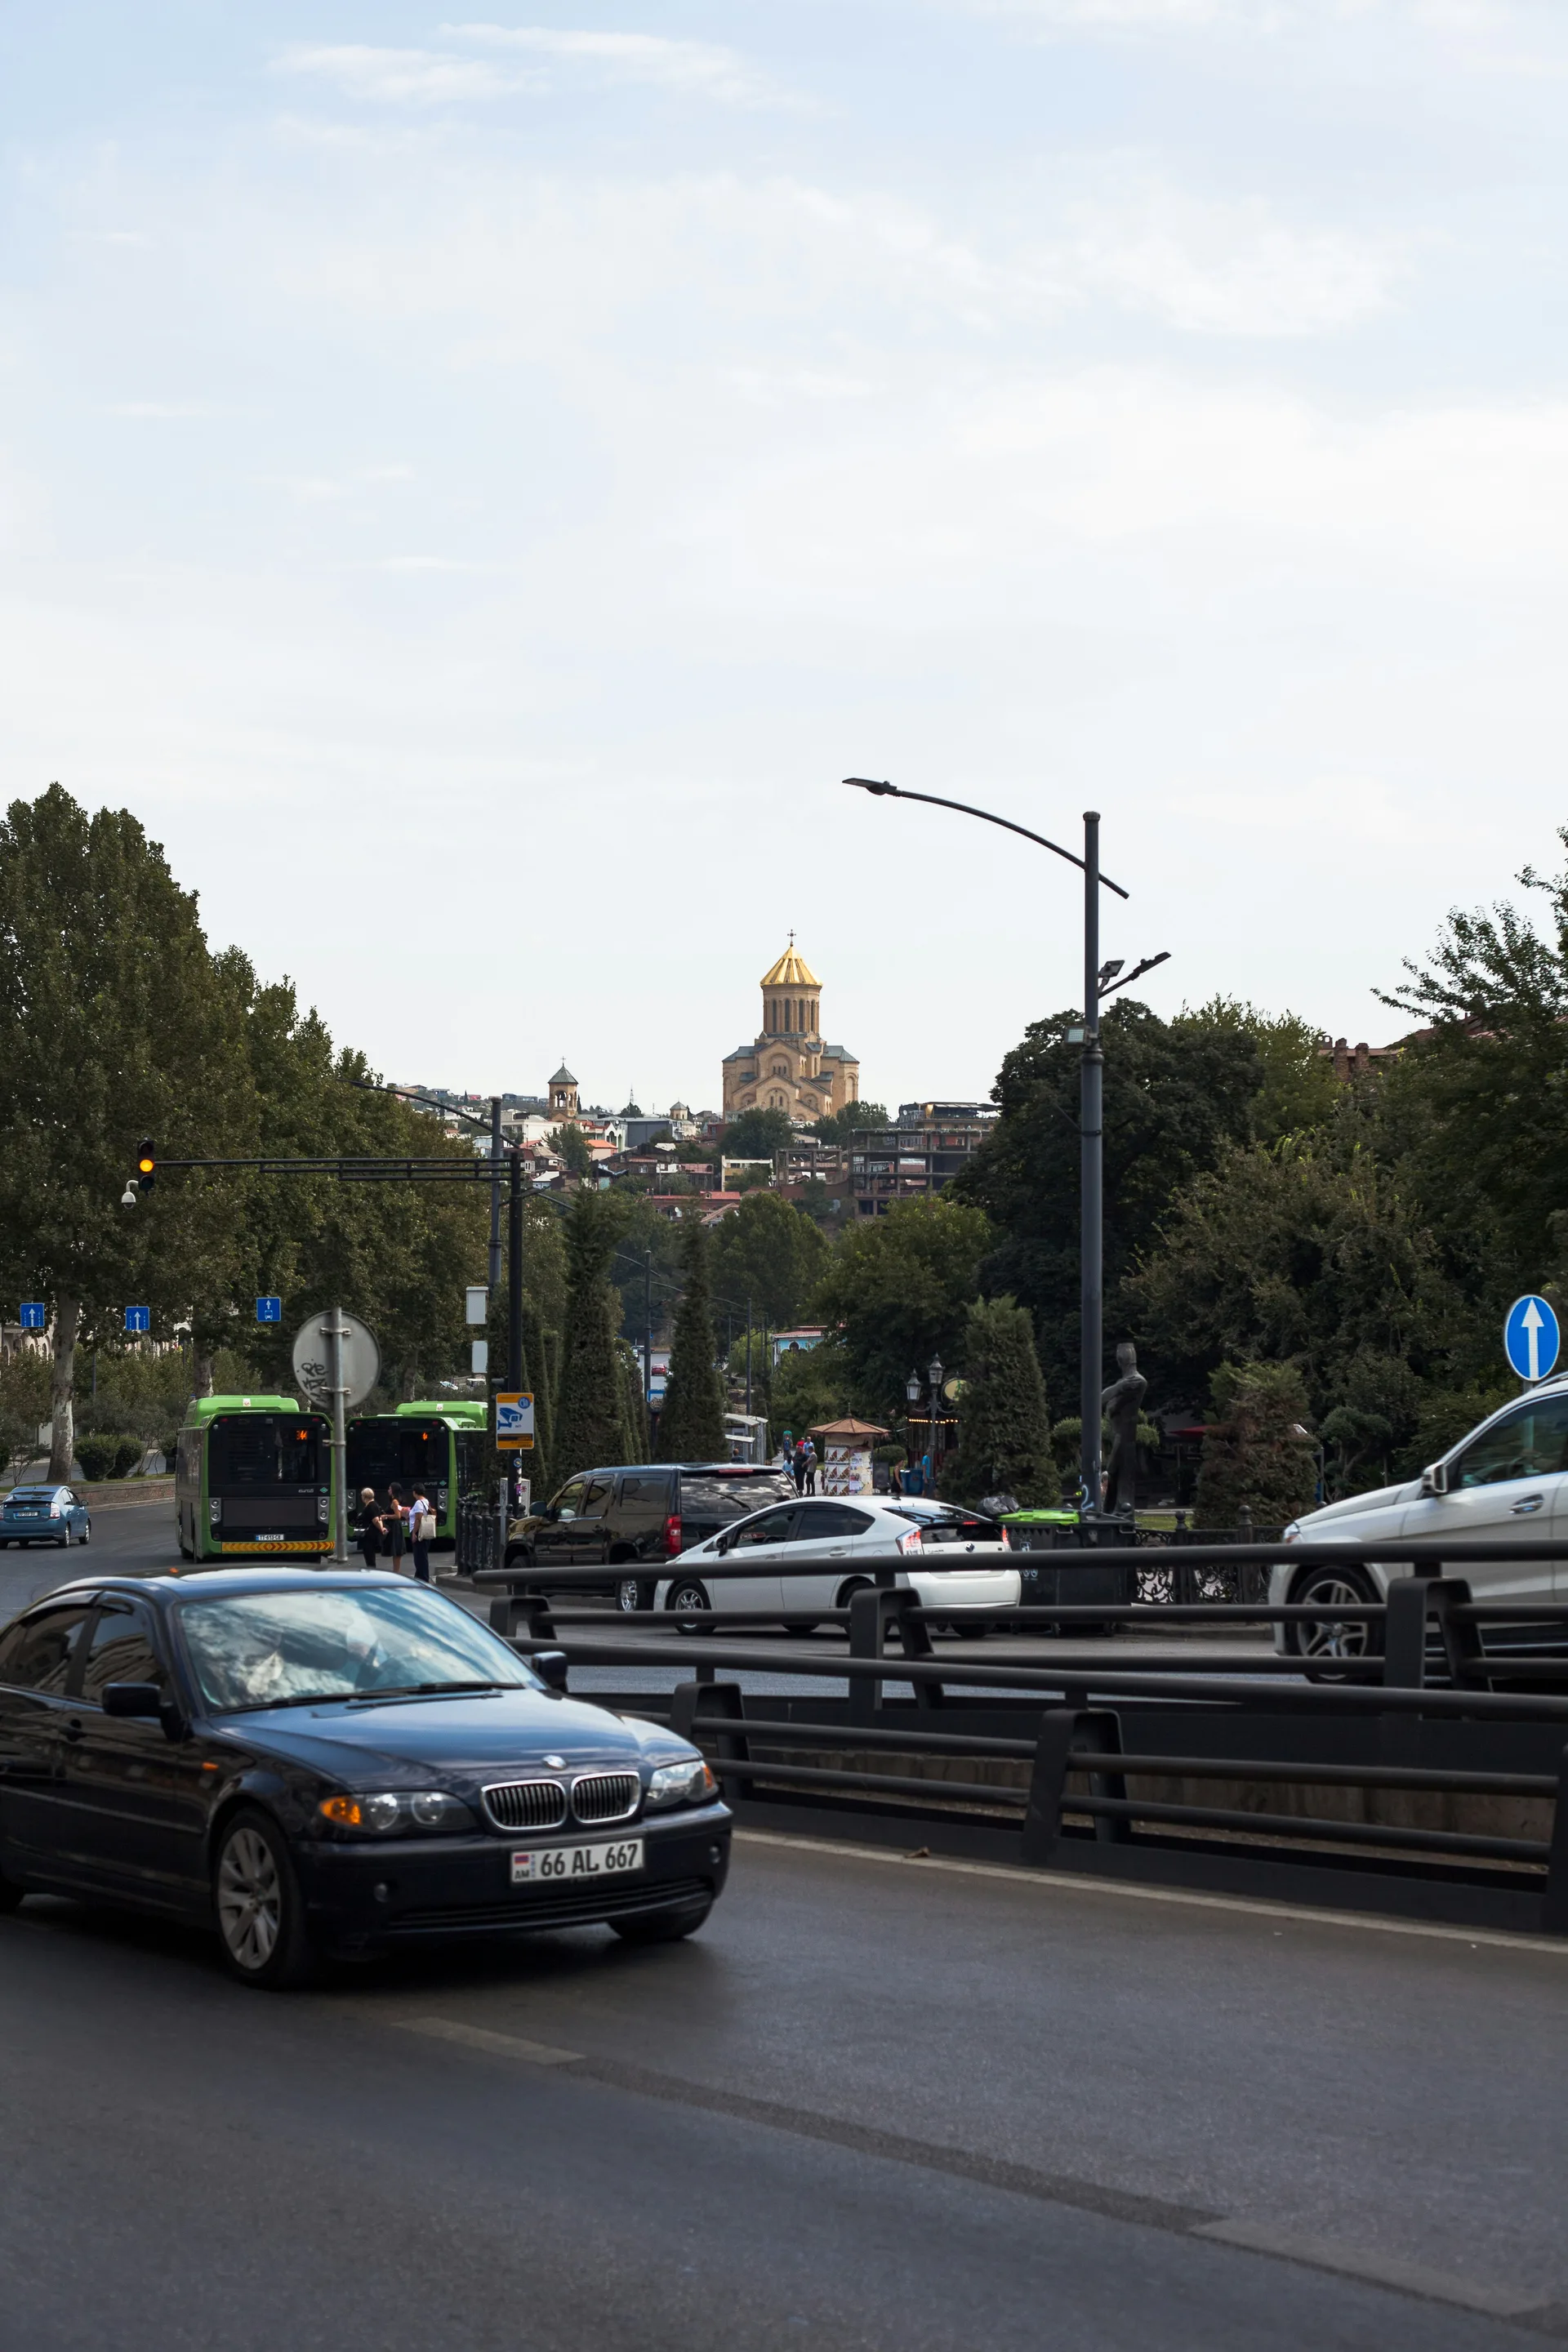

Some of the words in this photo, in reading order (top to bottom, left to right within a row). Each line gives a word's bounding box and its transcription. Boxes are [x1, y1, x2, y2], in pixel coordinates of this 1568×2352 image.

[540, 1852, 566, 1878] 66
[571, 1849, 599, 1875] AL
[604, 1843, 639, 1870] 667
[514, 1869, 529, 1880] AM
